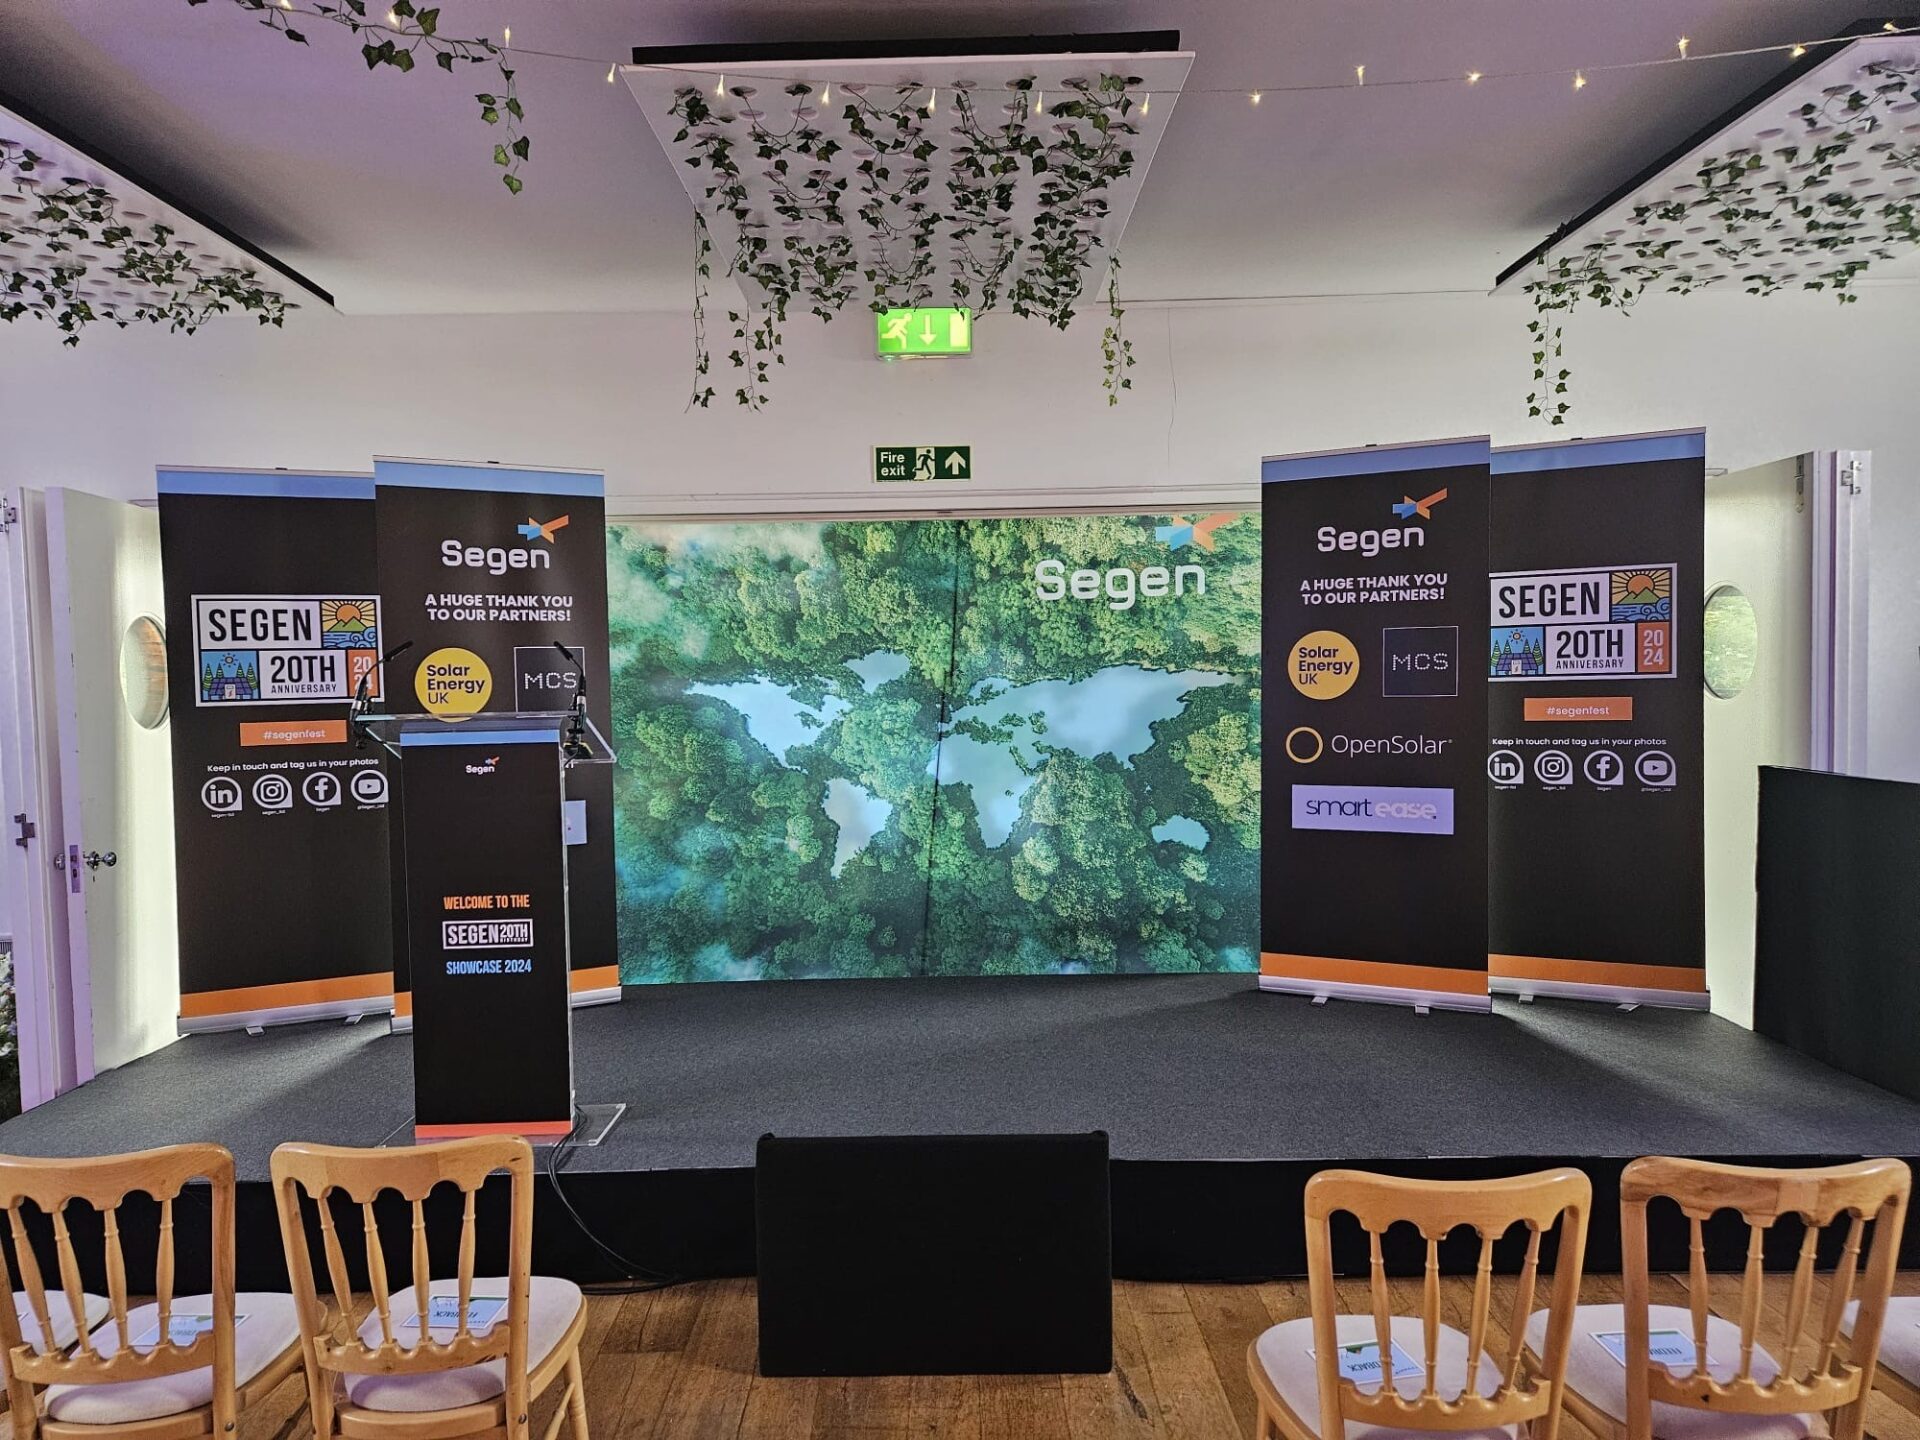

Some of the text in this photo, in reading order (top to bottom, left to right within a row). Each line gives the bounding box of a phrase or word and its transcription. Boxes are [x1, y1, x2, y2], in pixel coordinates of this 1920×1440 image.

[880, 452, 905, 463] Fire
[881, 465, 906, 476] exit
[1317, 526, 1425, 557] Segen
[441, 539, 550, 576] Segen
[1035, 559, 1206, 610] Segen
[1300, 573, 1448, 592] A HUGE THANK YOU
[425, 593, 573, 607] A HUGE THANK YOU
[1302, 587, 1445, 605] TO OUR PARTNERS!
[1498, 582, 1600, 619] SEGEN
[427, 608, 572, 622] TO OUR PARTNERS!
[208, 608, 312, 642] SEGEN
[1556, 629, 1623, 659] 20TH
[1643, 629, 1664, 647] 20
[1298, 646, 1339, 659] Solar
[1643, 649, 1664, 665] 24
[270, 655, 337, 684] 20TH
[353, 656, 372, 673] 20
[1298, 660, 1353, 675] Energy
[1392, 652, 1449, 671] MCS
[1555, 659, 1625, 669] ANNIVERSARY
[426, 664, 470, 677] Solar
[427, 678, 486, 694] Energy
[524, 672, 578, 690] MCS
[1298, 673, 1318, 685] UK
[271, 684, 337, 694] ANNIVERSARY
[427, 692, 449, 704] UK
[1546, 706, 1610, 717] #segenfest
[263, 729, 326, 741] #segenfest
[1492, 738, 1514, 747] Keep
[1571, 738, 1587, 746] tag
[1634, 738, 1667, 746] photos
[1331, 734, 1448, 759] OpenSolar
[207, 764, 231, 773] Keep
[242, 762, 268, 771] touch
[270, 761, 288, 769] and
[289, 761, 305, 770] tag
[328, 759, 348, 769] your
[349, 757, 379, 768] photos
[465, 764, 495, 775] Segen
[1494, 757, 1516, 777] in
[210, 784, 233, 805] in
[1306, 798, 1373, 817] smart
[443, 894, 530, 910] WELCOME TO THE
[447, 923, 528, 945] SEGEN 20TH
[446, 958, 532, 975] SHOWCASE 2024
